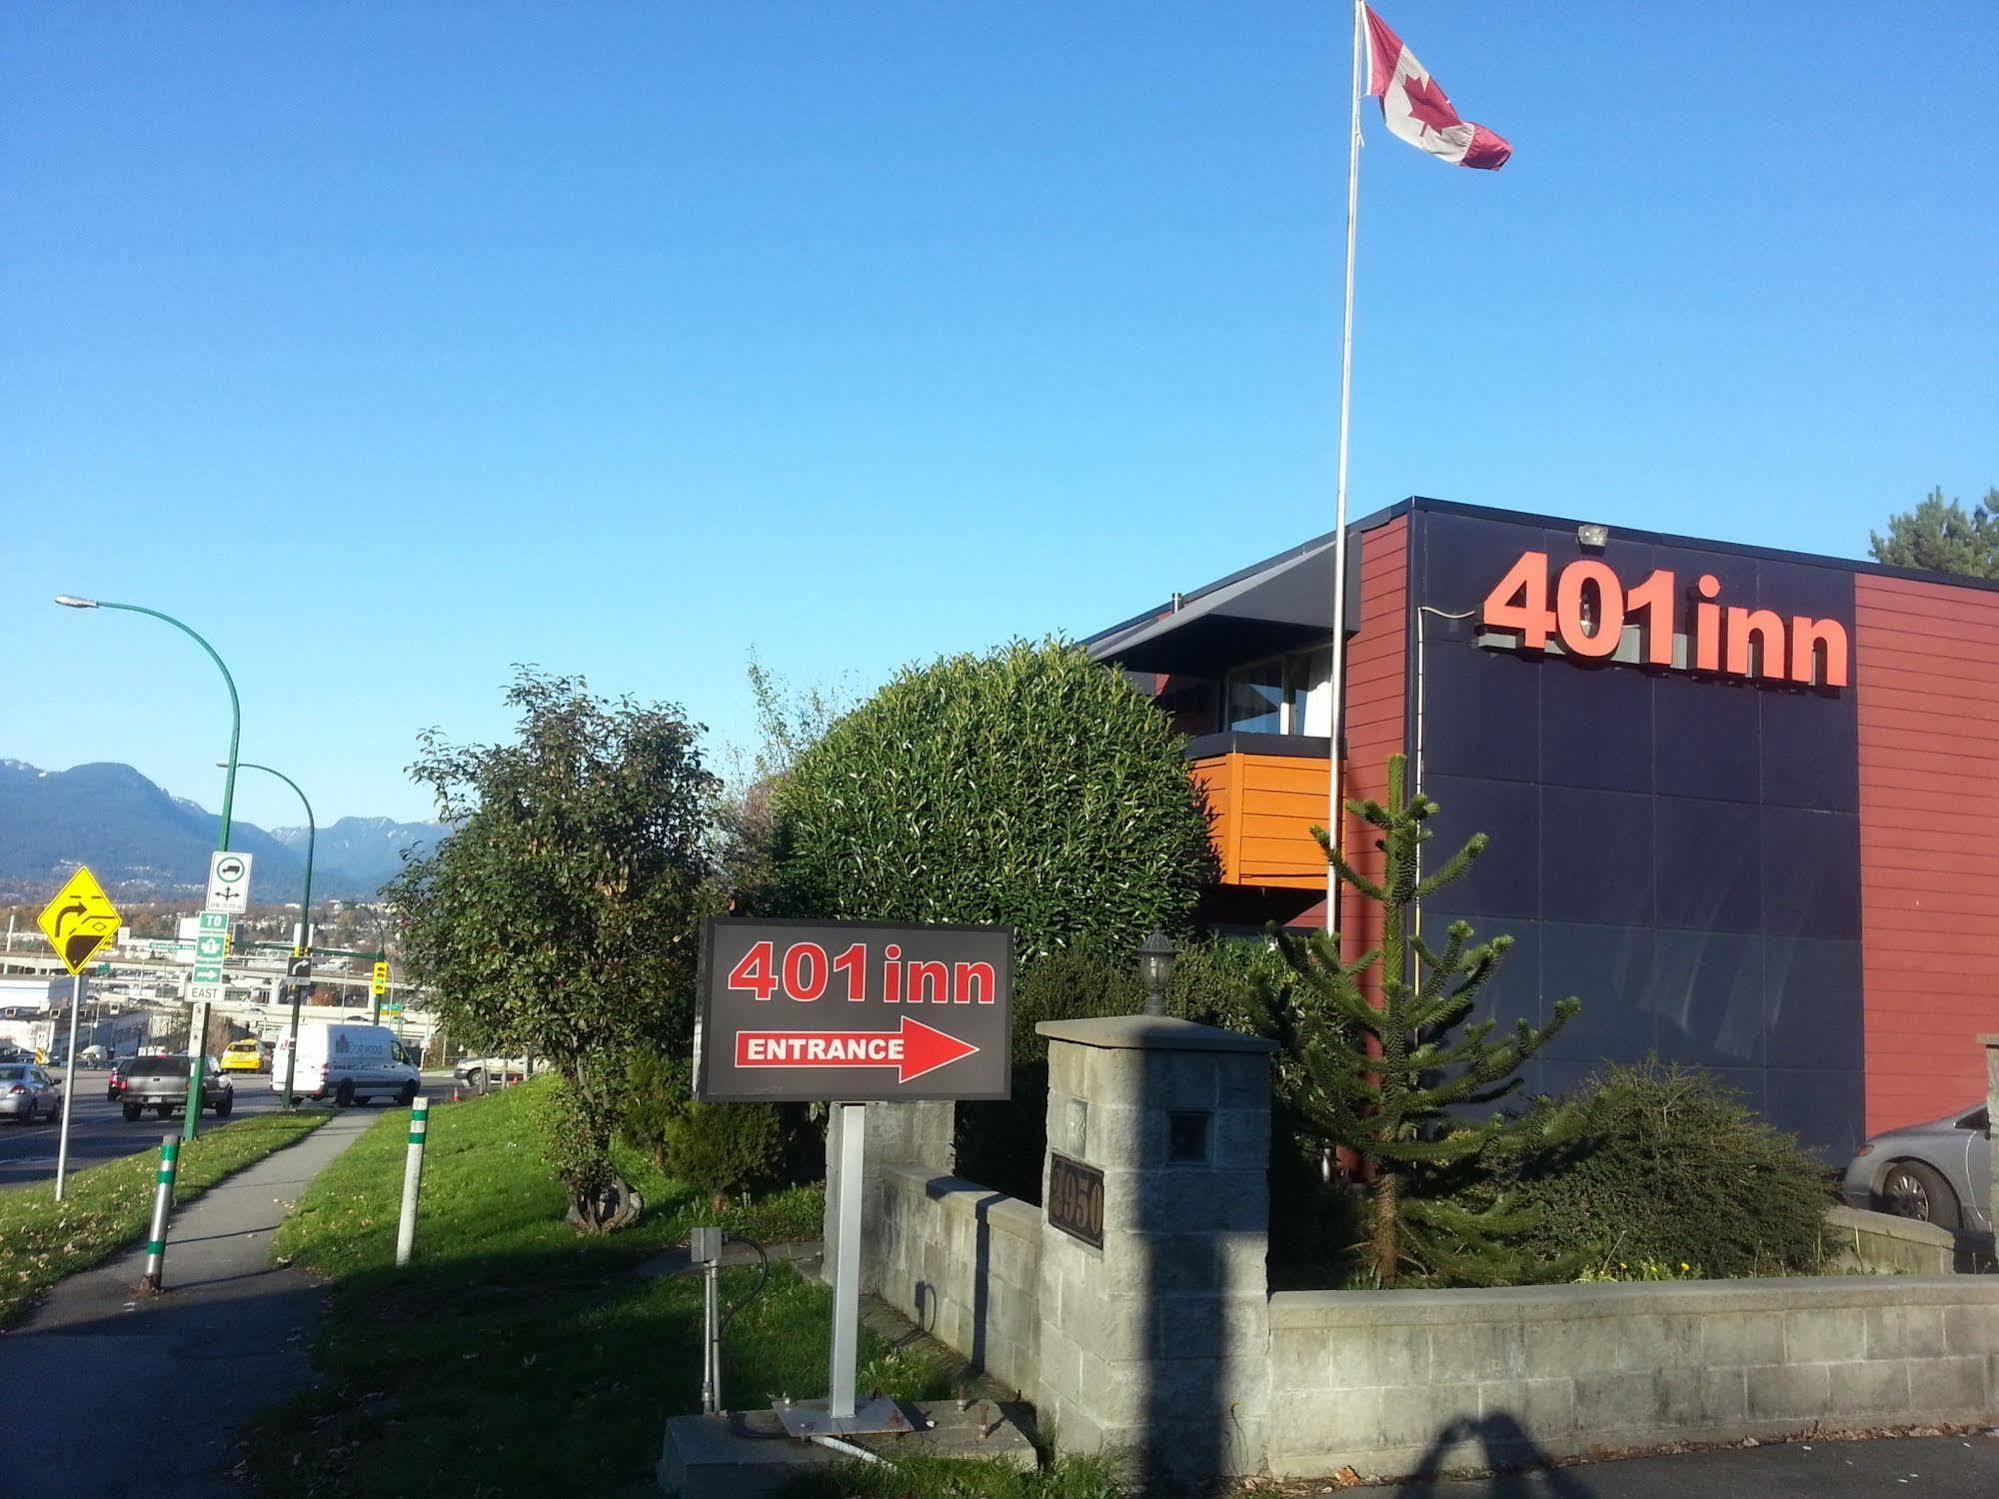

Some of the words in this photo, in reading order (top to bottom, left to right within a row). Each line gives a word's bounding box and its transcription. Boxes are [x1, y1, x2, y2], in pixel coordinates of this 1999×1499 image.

[1483, 551, 1675, 665] 401
[1697, 575, 1847, 687] inn
[206, 915, 222, 927] TO
[728, 940, 867, 1003] 401
[883, 943, 996, 1005] inn
[191, 987, 218, 999] EAST
[747, 1038, 905, 1060] ENTRANCE
